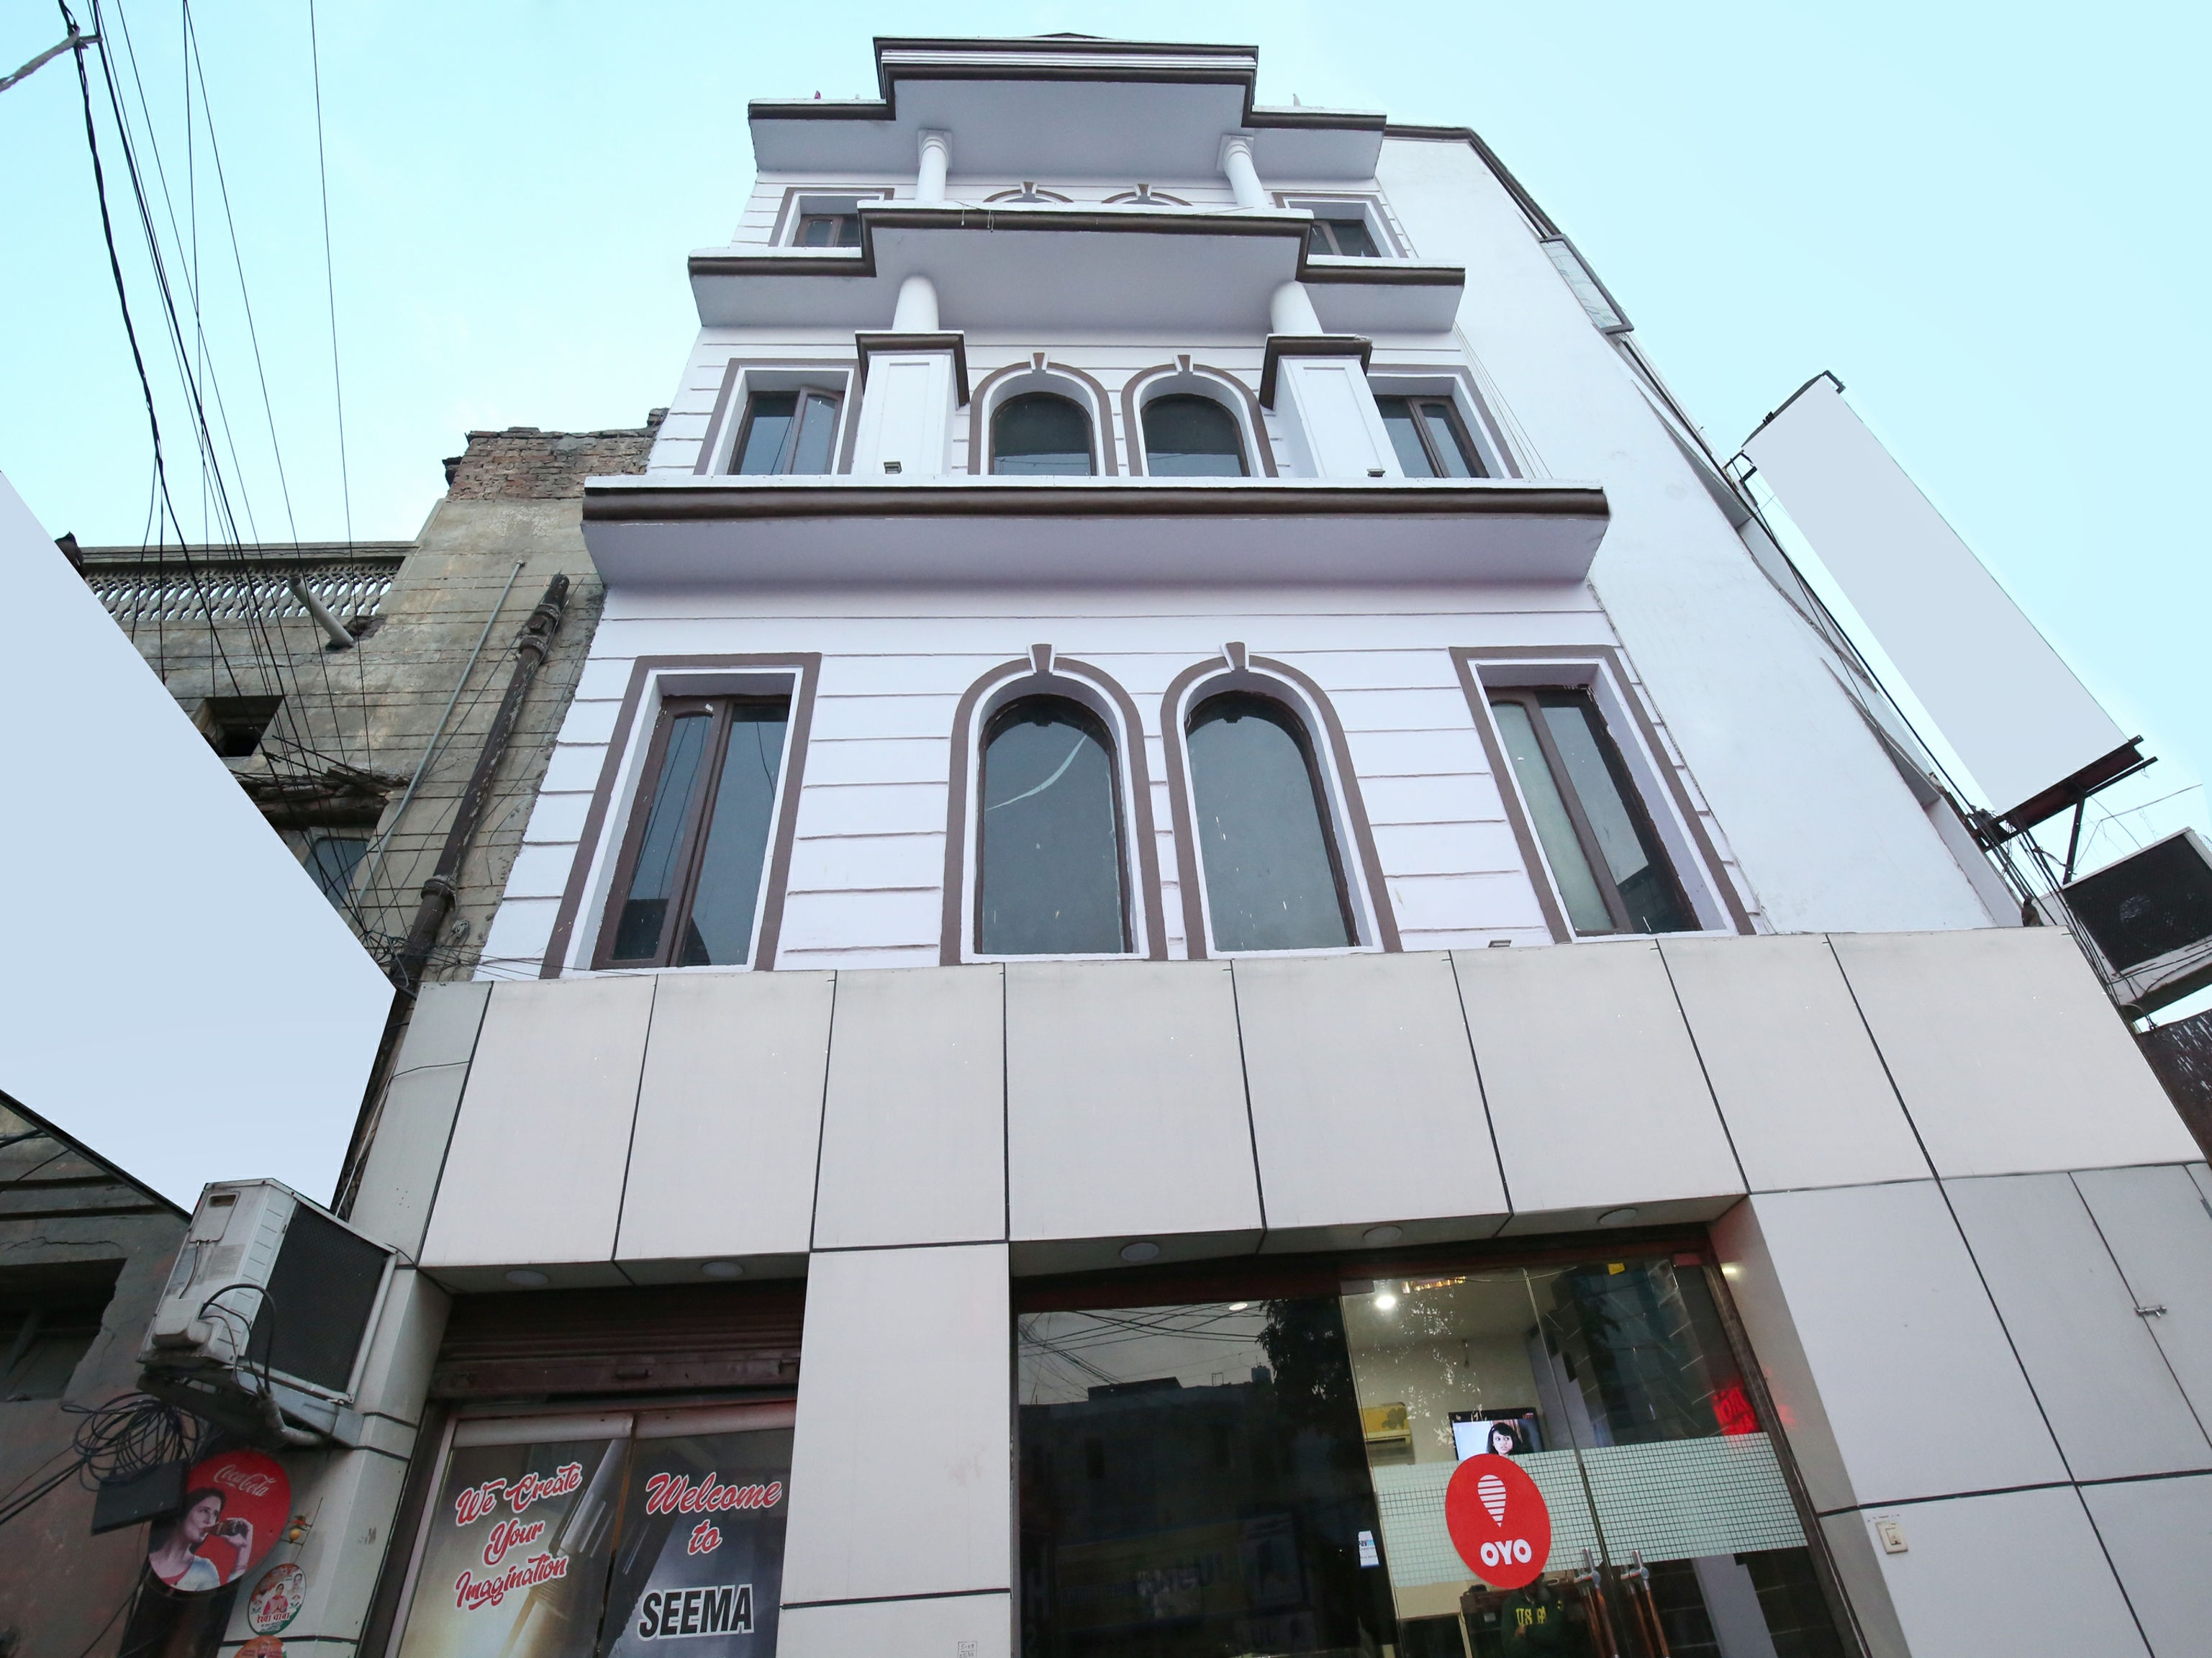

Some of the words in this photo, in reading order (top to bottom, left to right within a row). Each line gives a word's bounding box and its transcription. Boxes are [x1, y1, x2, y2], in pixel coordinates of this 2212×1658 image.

[455, 1478, 506, 1526] We
[504, 1462, 581, 1513] Create
[645, 1472, 782, 1514] Welcome
[483, 1518, 545, 1567] Your
[687, 1519, 723, 1555] to
[1480, 1539, 1532, 1567] OYO
[455, 1553, 568, 1611] Imagination
[639, 1585, 753, 1640] SEEMA
